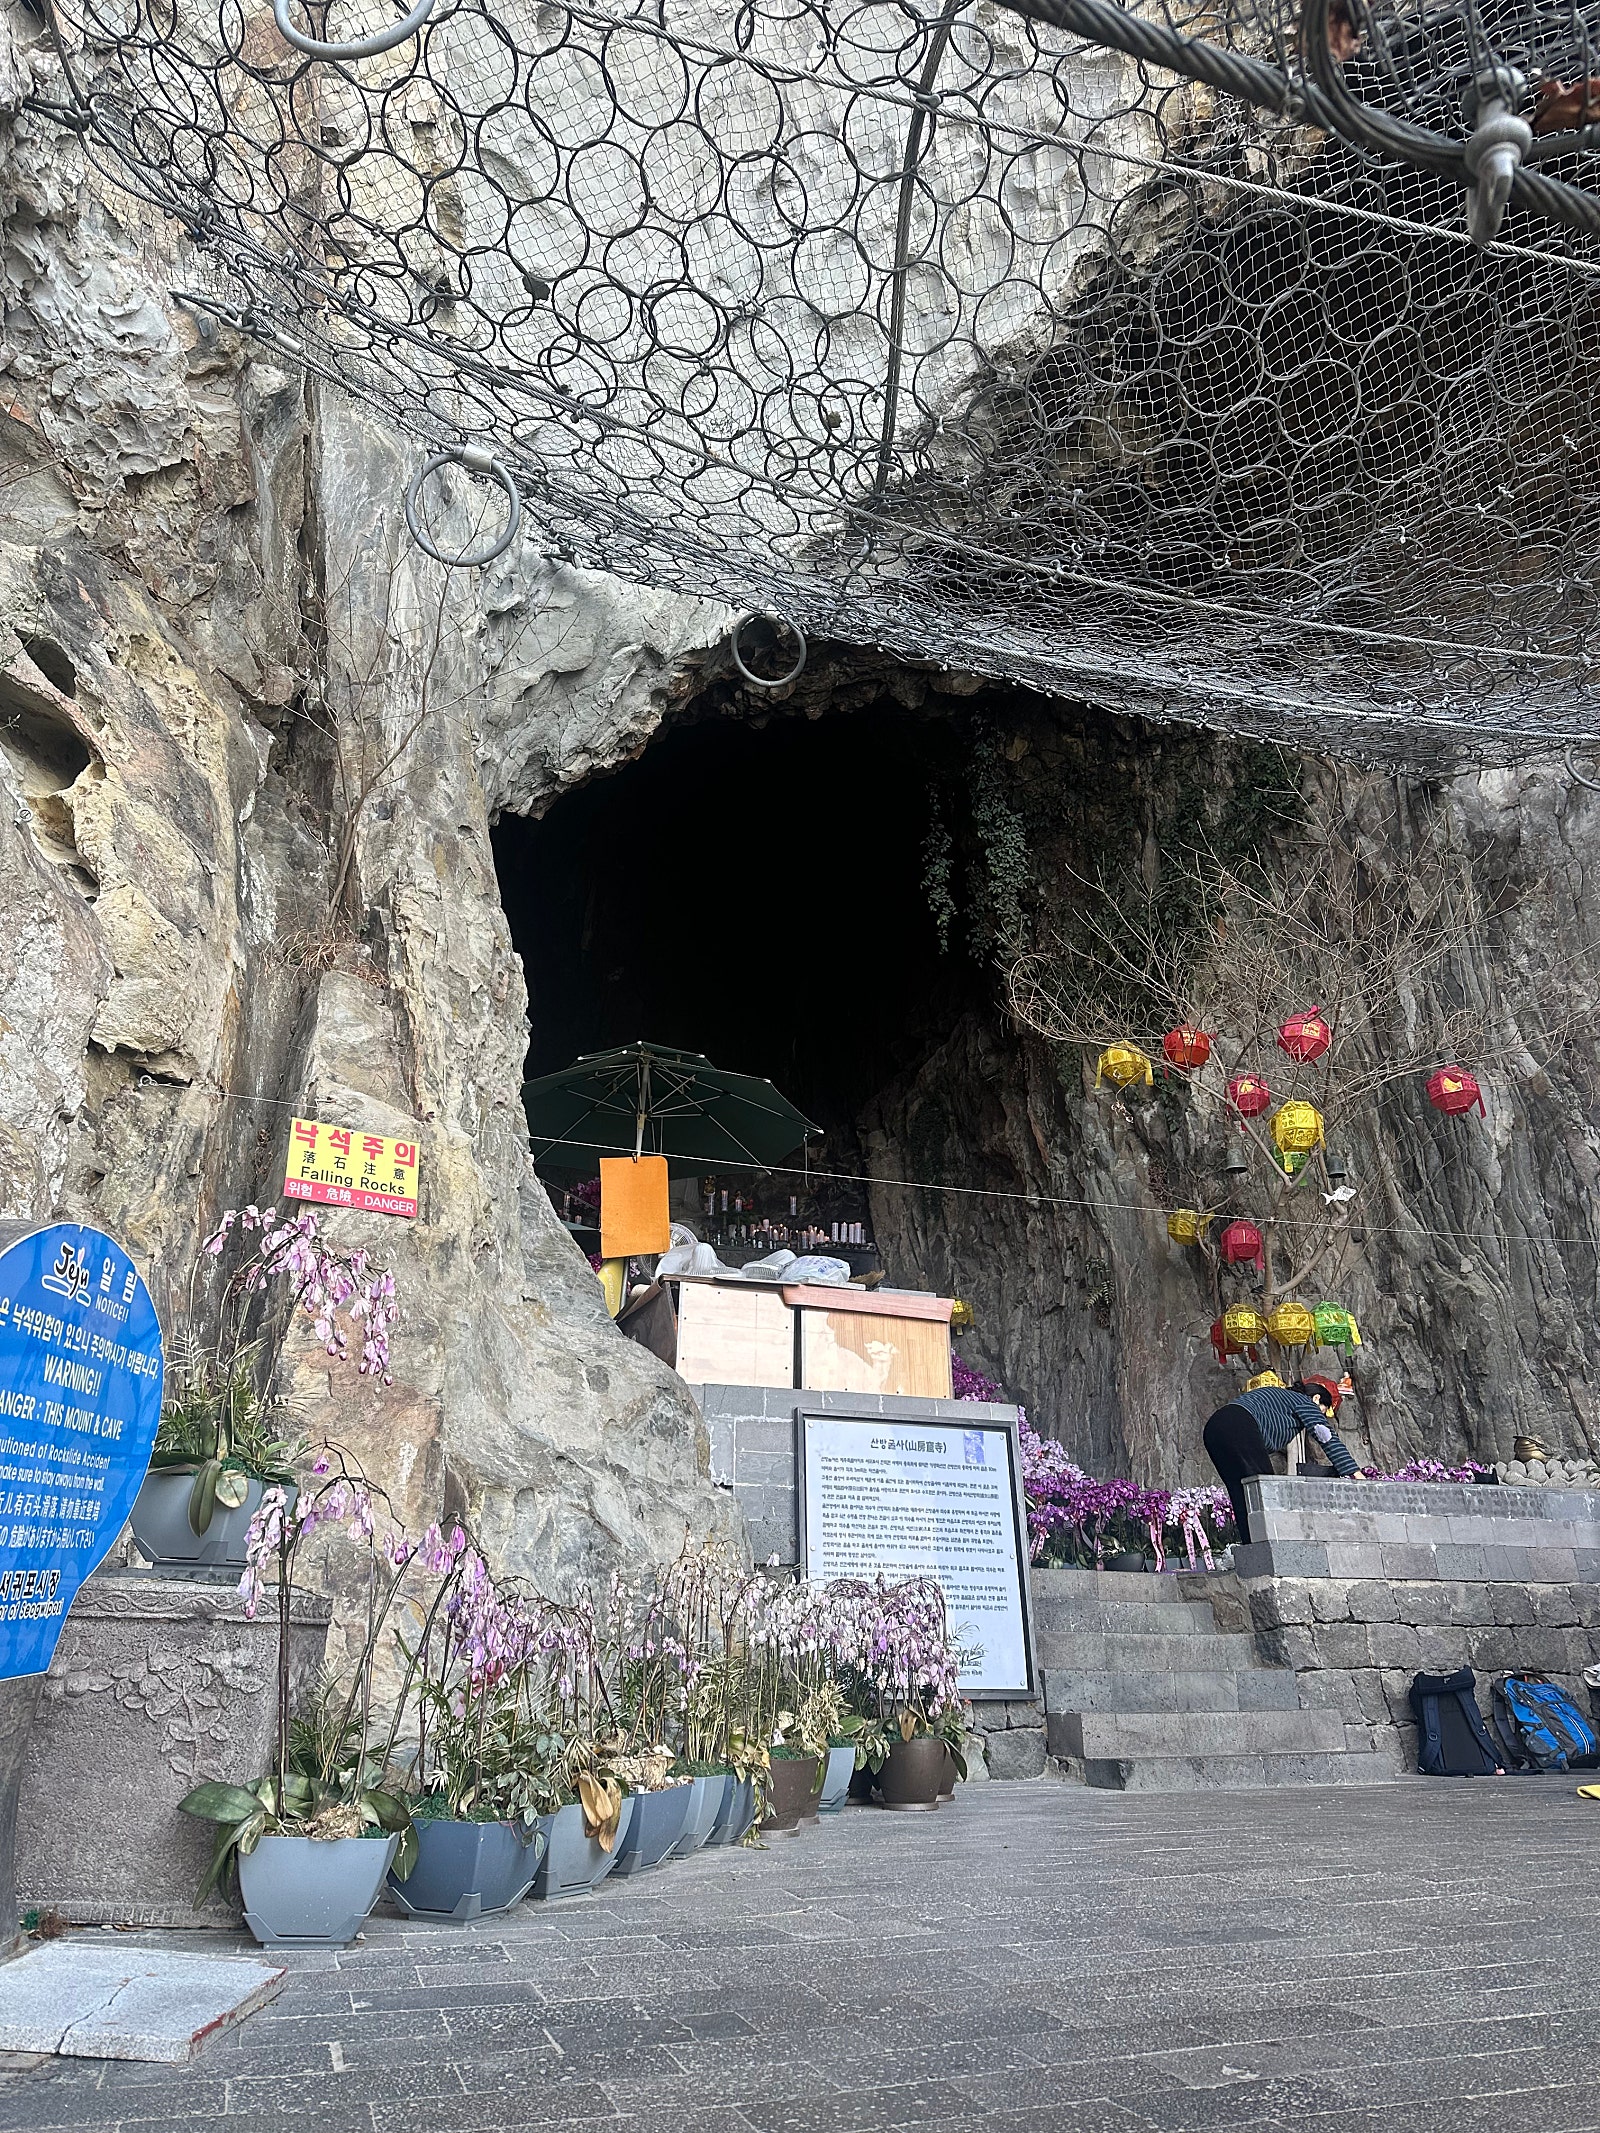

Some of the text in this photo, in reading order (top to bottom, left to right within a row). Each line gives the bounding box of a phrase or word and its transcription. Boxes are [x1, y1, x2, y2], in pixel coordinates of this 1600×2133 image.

[295, 1121, 416, 1168] 낙석주의
[301, 1166, 405, 1195] Falling Rocks
[302, 1150, 406, 1181] 落石注意
[288, 1181, 313, 1197] 위험
[364, 1195, 415, 1213] DANGER
[95, 1294, 130, 1323] NOTICE!!
[12, 1303, 65, 1346] 낙석위험이
[63, 1323, 92, 1355] 있으니
[90, 1334, 127, 1370] 주의하시기
[126, 1349, 159, 1380] 바랍니다.
[43, 1354, 103, 1397] WARNING!!
[43, 1400, 65, 1427] THIS
[63, 1406, 95, 1434] MOUNT
[93, 1414, 101, 1436] &
[101, 1416, 124, 1441] CAVE
[0, 1436, 111, 1470] utioned of Rockslide Accident
[17, 1466, 34, 1483] sure
[33, 1466, 42, 1484] to
[41, 1468, 56, 1488] stay
[0, 1570, 61, 1601] 서귀포시장
[8, 1601, 21, 1620] of
